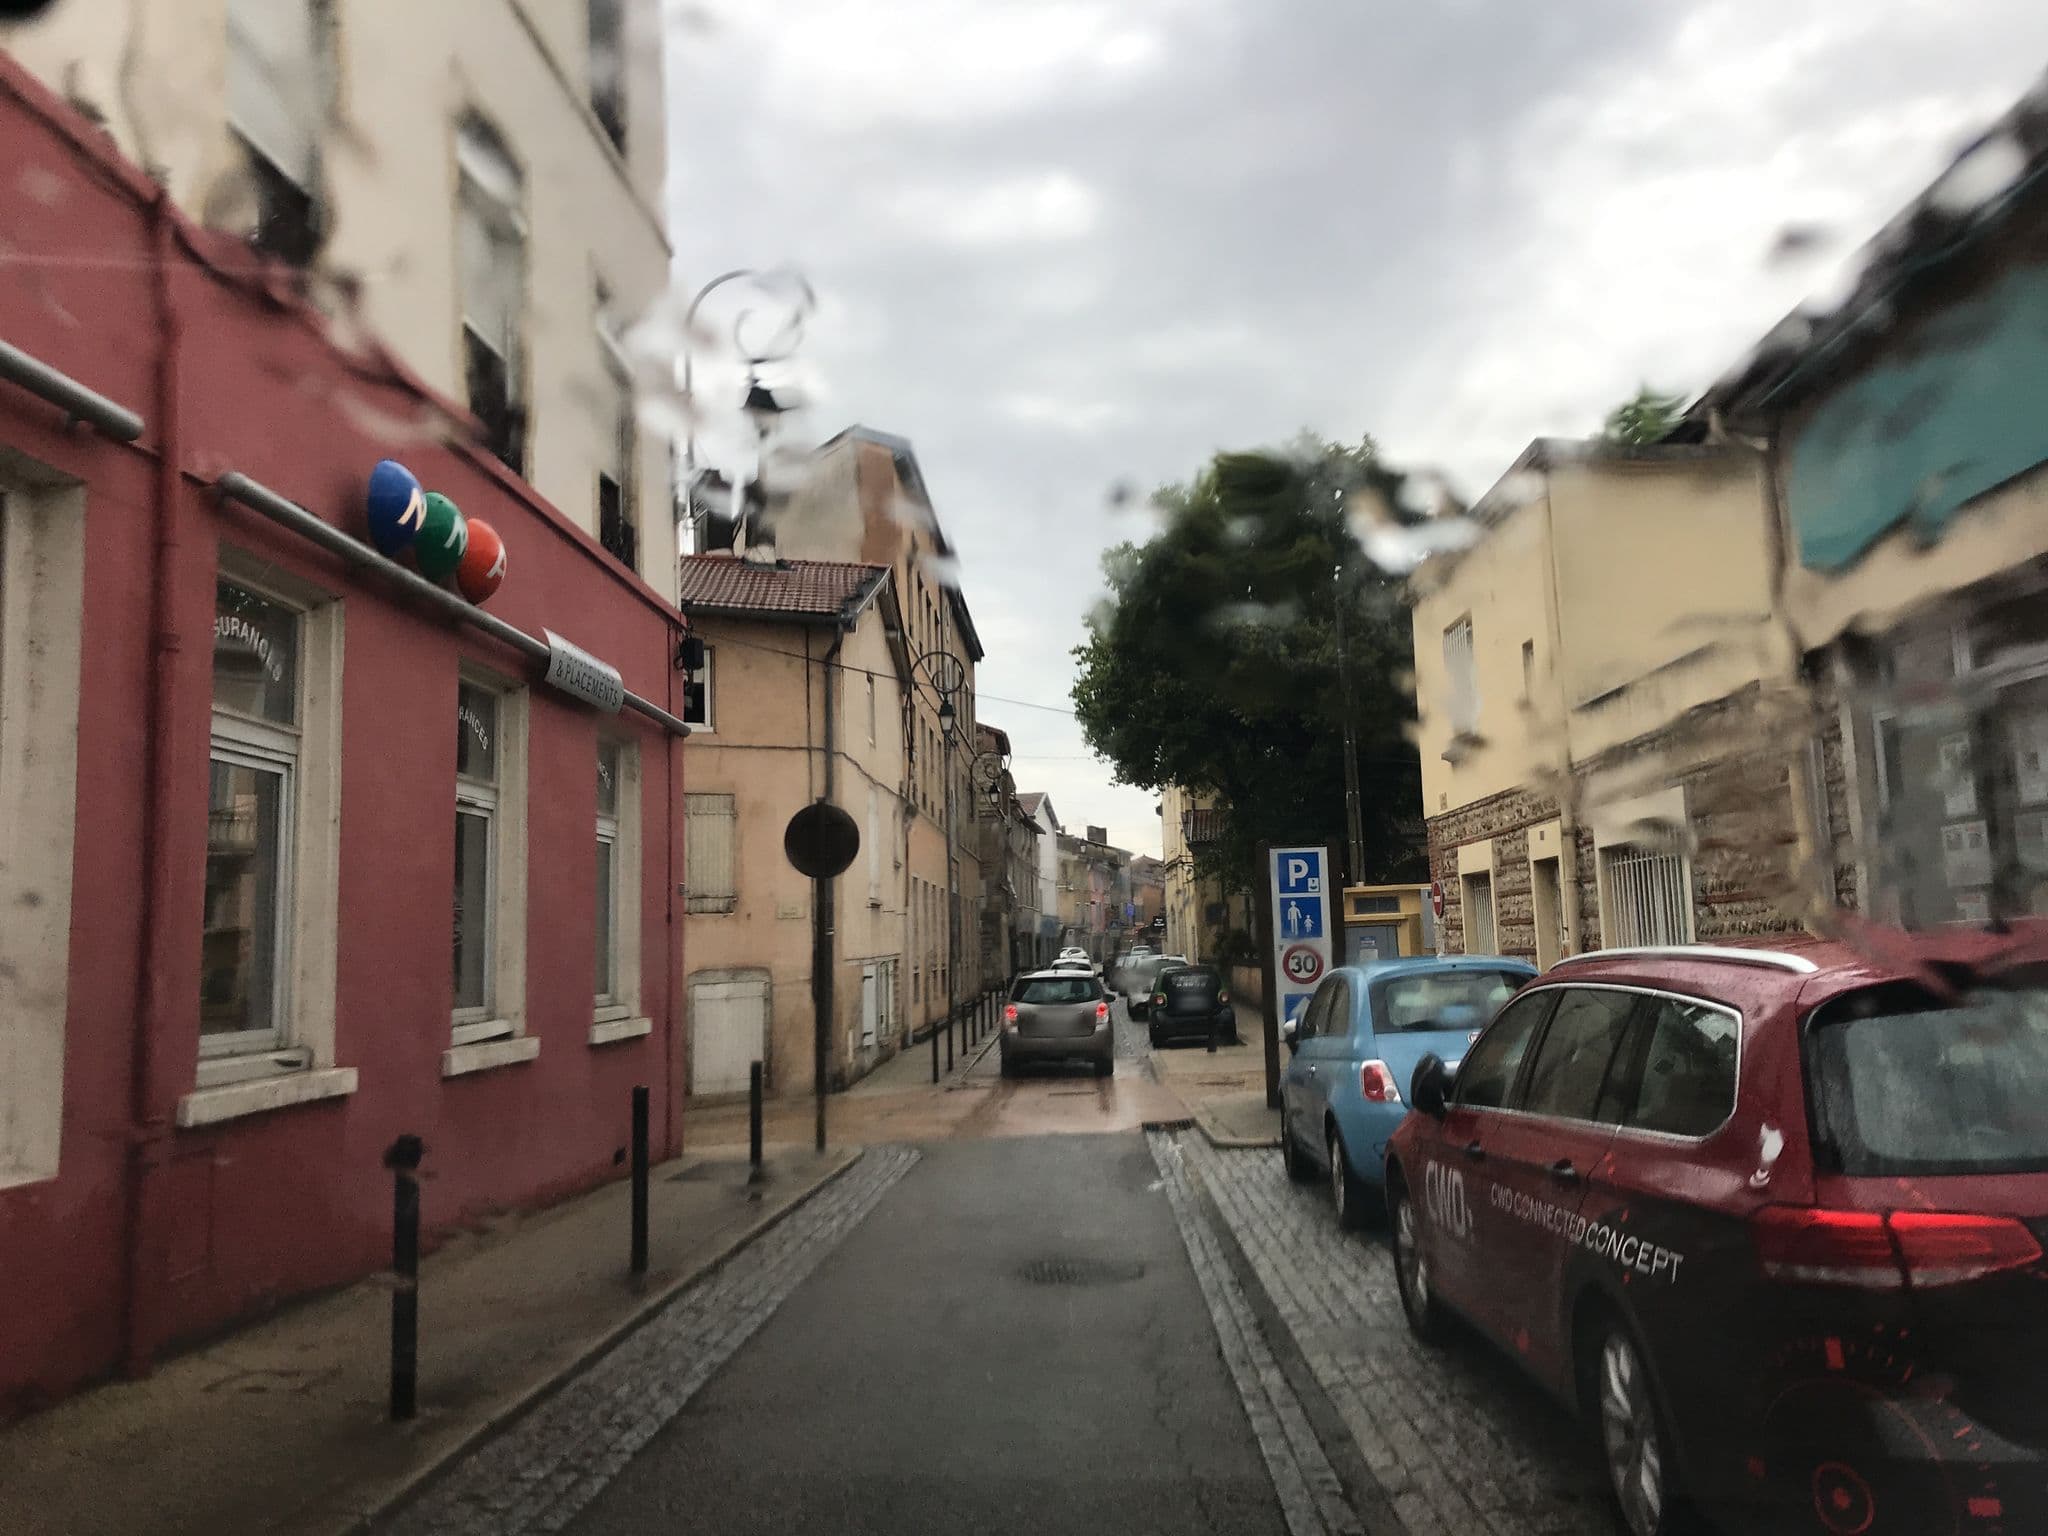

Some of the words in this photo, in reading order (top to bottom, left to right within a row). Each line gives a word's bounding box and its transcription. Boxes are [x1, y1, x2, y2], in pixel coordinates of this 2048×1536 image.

[556, 659, 564, 678] &
[564, 663, 618, 707] PLACEMENTS
[1288, 858, 1309, 888] P
[1291, 954, 1317, 974] 30
[1514, 1191, 1586, 1245] CONNECTED
[1585, 1221, 1684, 1284] CONCEPT
